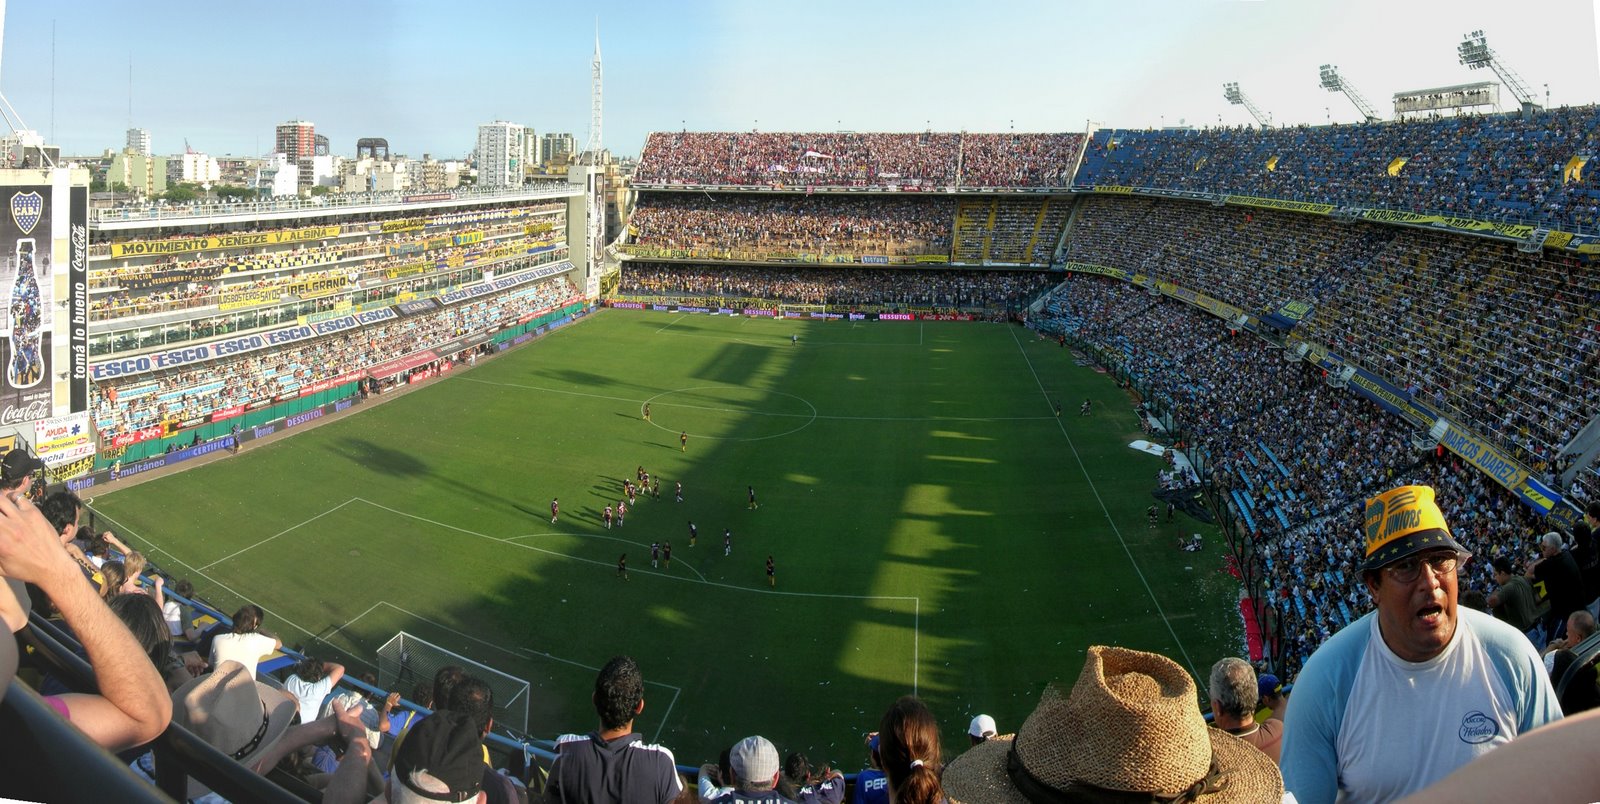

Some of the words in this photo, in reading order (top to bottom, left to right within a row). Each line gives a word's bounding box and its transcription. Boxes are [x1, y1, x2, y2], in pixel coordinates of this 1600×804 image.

[14, 206, 39, 216] CABJ
[1272, 201, 1310, 210] PRESIDENTE
[1310, 204, 1331, 212] 2007
[432, 214, 478, 226] AGRUPACION
[72, 223, 86, 272] Coca-Cola
[122, 239, 208, 255] MOVIMIENTO
[218, 234, 268, 248] XENEIZE
[290, 228, 327, 240] ALSINA
[537, 267, 554, 278] ESCO
[556, 262, 572, 272] ESCO
[496, 278, 516, 289] ESCO
[517, 272, 536, 282] ESCO
[442, 290, 467, 304] ESCO
[470, 284, 494, 296] ESCO
[72, 282, 85, 324] bueno
[358, 307, 394, 324] ESCO
[73, 328, 85, 340] lo
[316, 316, 356, 334] ESCO
[268, 326, 312, 345] ESCO
[214, 336, 262, 356] ESCO
[72, 345, 85, 380] tomá
[156, 346, 208, 368] ESCO
[94, 358, 150, 378] ESCO
[1, 400, 50, 425] Coca-Cola
[287, 409, 323, 427] DESSUTOL
[45, 426, 68, 438] AYUDA
[193, 436, 234, 456] CERTIFICAD
[1443, 429, 1480, 460] MARCOS
[1476, 450, 1516, 484] JUAREZ
[1384, 509, 1422, 539] JUNIORS
[1463, 726, 1492, 737] Helados
